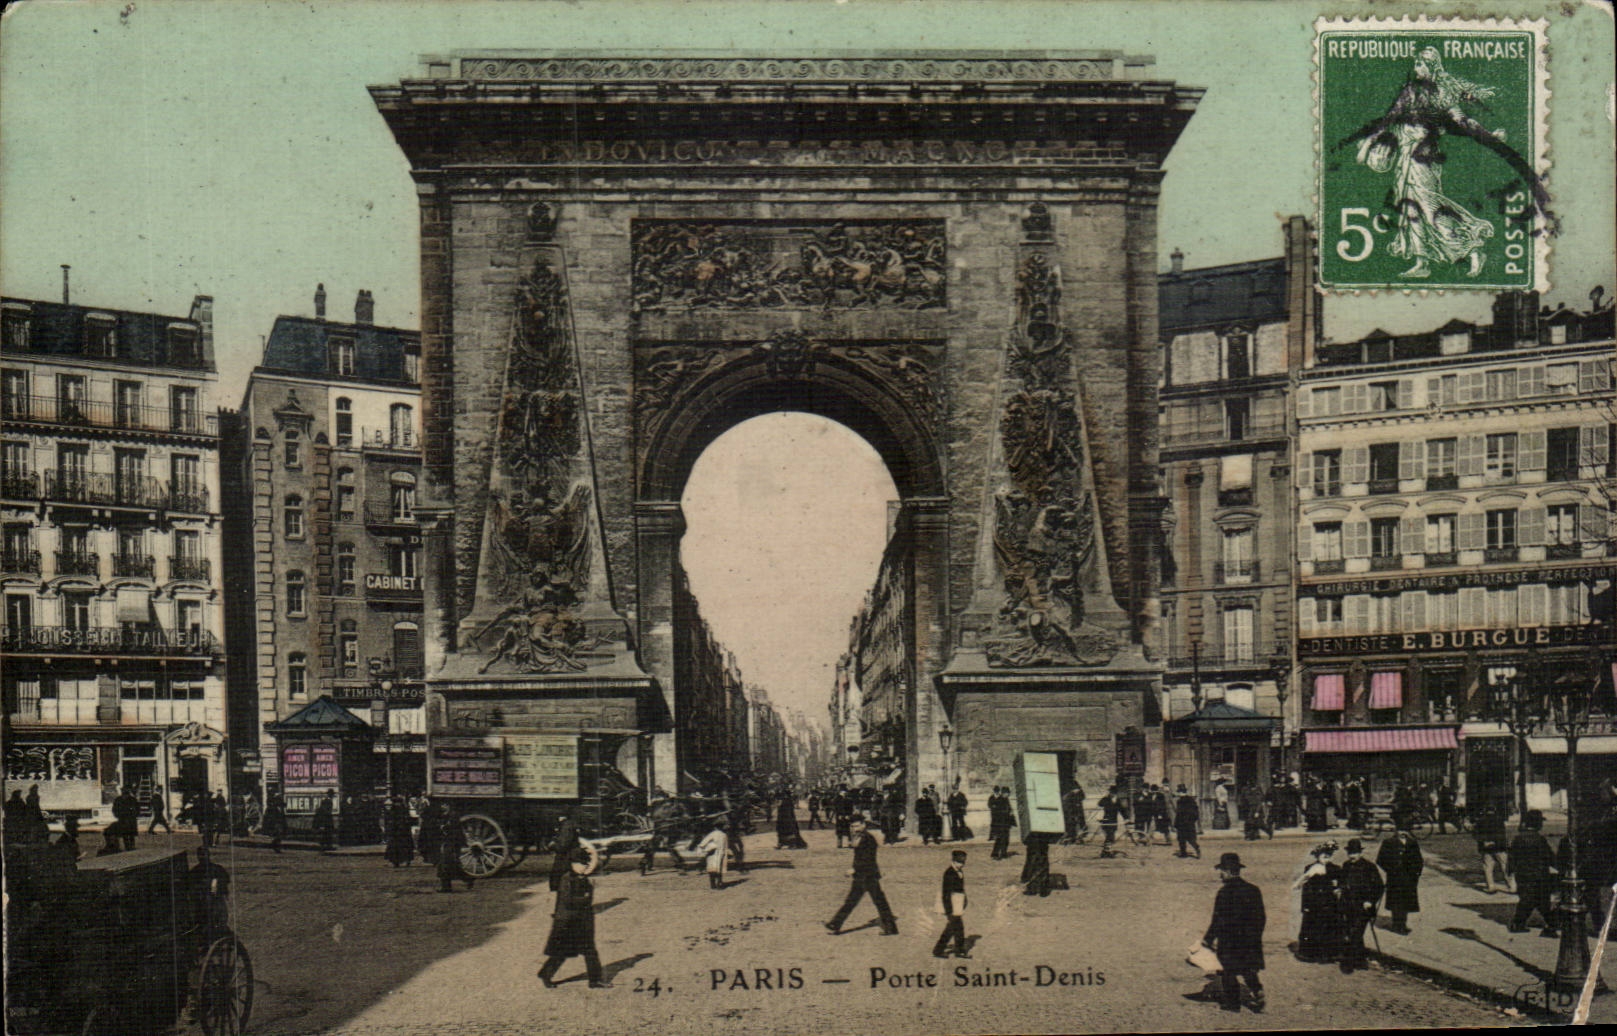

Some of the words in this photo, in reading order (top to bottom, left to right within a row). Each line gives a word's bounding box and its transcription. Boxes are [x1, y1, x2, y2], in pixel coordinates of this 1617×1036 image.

[1328, 40, 1417, 60] REPUBLIQUE
[1443, 40, 1525, 60] FRANÇAISE
[1504, 190, 1525, 275] POSTES
[366, 575, 415, 590] CABINET
[1317, 581, 1380, 593] CHIRURGIE
[1390, 577, 1445, 589] DENTAIRE
[1466, 571, 1528, 585] PROTHESE
[1312, 636, 1389, 652] DENTISTE
[284, 764, 310, 777] PICON
[312, 764, 338, 777] PICON
[286, 797, 310, 810] AMER
